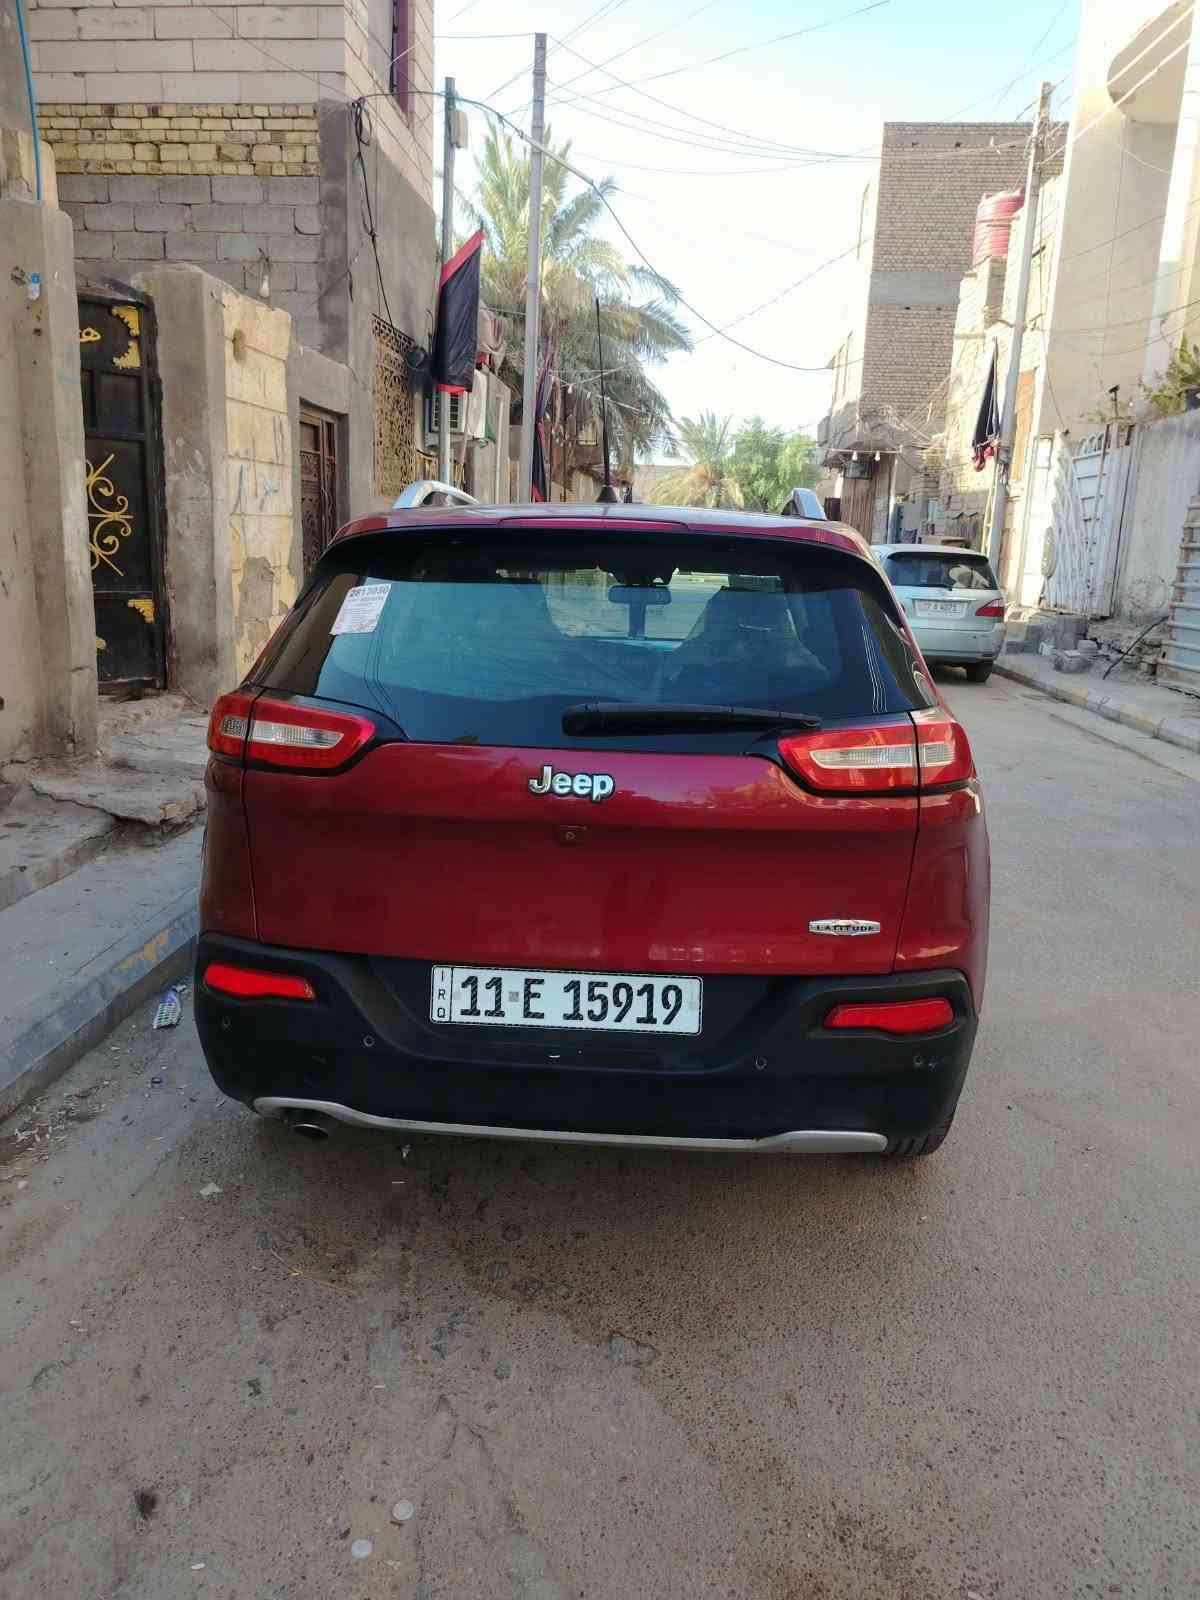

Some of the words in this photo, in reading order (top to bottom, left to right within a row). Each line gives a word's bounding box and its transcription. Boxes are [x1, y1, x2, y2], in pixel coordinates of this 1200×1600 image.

[528, 764, 615, 802] Jeep
[815, 924, 877, 933] LATITUDE
[460, 976, 506, 1018] 11
[523, 978, 545, 1019] E
[563, 980, 683, 1025] 15919
